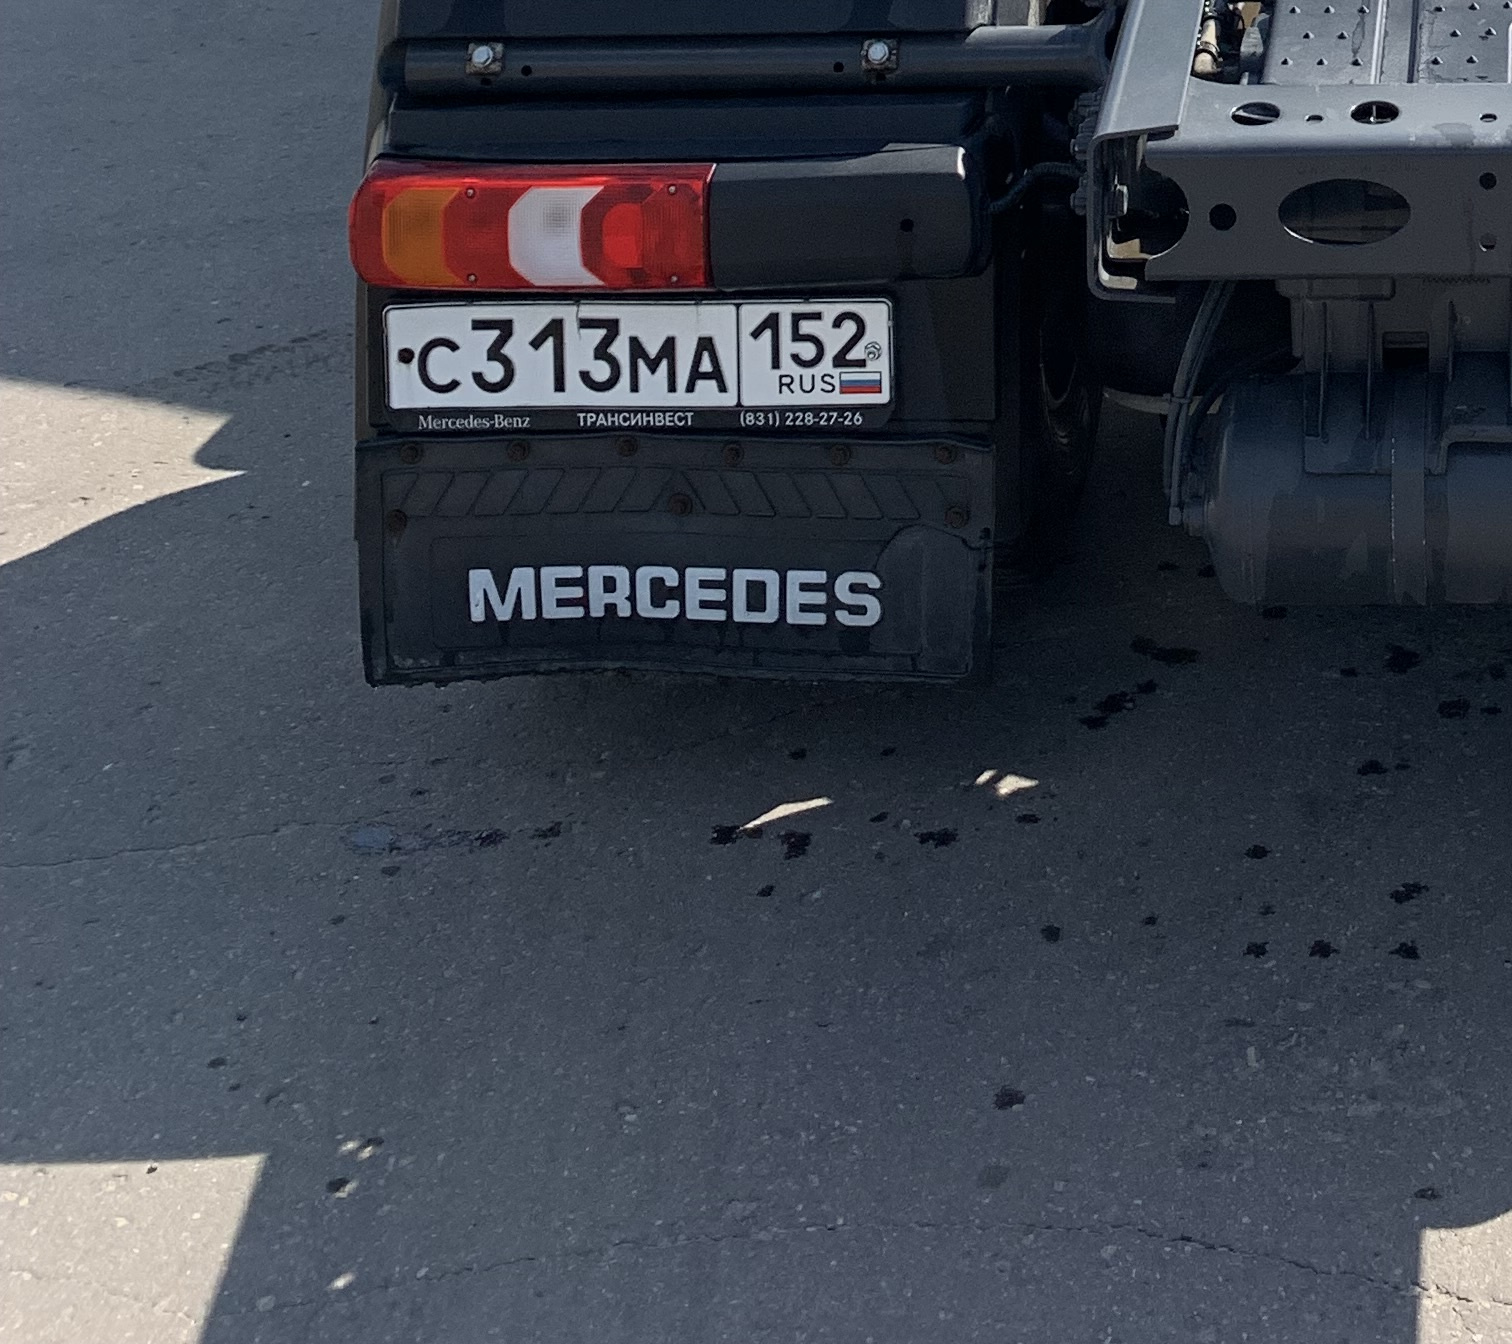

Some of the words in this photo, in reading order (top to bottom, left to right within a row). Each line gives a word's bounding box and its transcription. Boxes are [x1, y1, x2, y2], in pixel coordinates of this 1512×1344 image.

[749, 312, 868, 369] 152
[778, 372, 836, 395] RUS
[418, 414, 531, 430] Mercedes-Benz
[577, 412, 694, 428] ТРАНСИНВЕСТ
[740, 411, 780, 428] (831)
[785, 411, 863, 427] 228-27-26
[467, 565, 883, 627] MERCEDES
